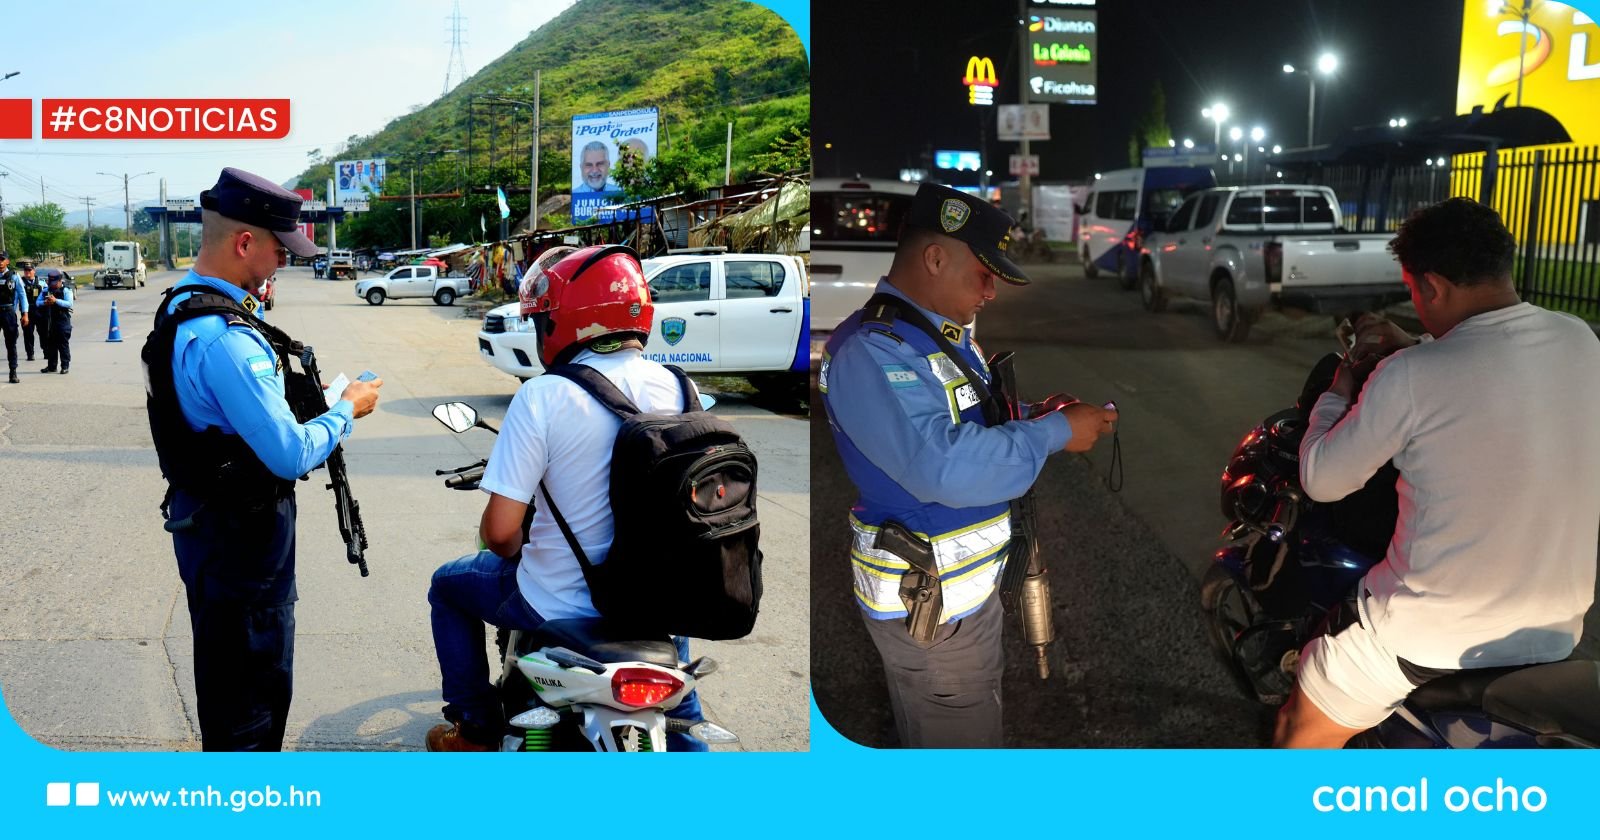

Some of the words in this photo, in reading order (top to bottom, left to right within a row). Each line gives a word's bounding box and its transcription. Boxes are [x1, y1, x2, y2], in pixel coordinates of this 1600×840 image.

[1033, 42, 1049, 60] La
[1043, 80, 1095, 95] Ficohsa
[610, 122, 655, 138] Orden!
[669, 352, 713, 363] NACIONAL
[534, 676, 563, 688] ITALIKA
